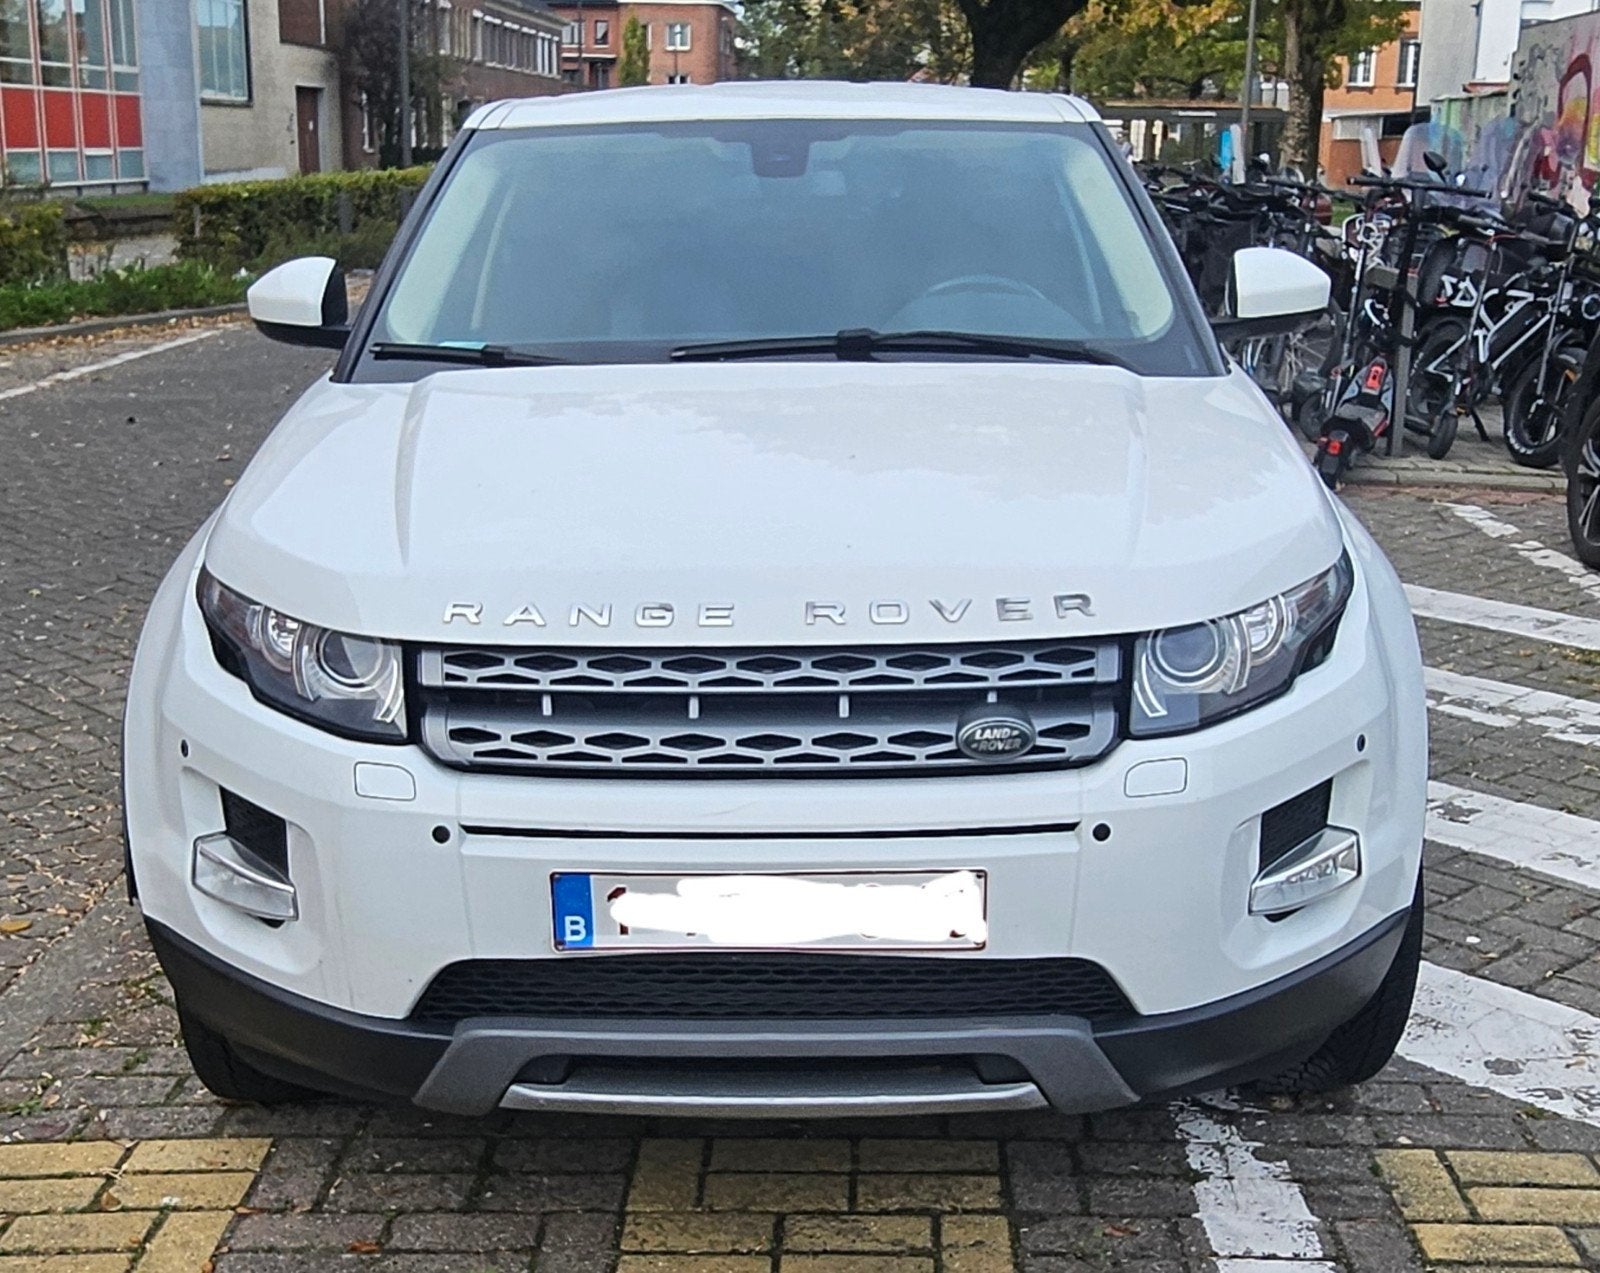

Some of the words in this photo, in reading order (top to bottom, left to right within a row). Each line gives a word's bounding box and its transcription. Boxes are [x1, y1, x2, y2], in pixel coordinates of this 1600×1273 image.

[442, 601, 735, 627] RANGE
[804, 593, 1097, 626] ROVER
[975, 727, 1011, 740] LAND
[978, 738, 1022, 751] ROVER
[564, 915, 587, 941] B
